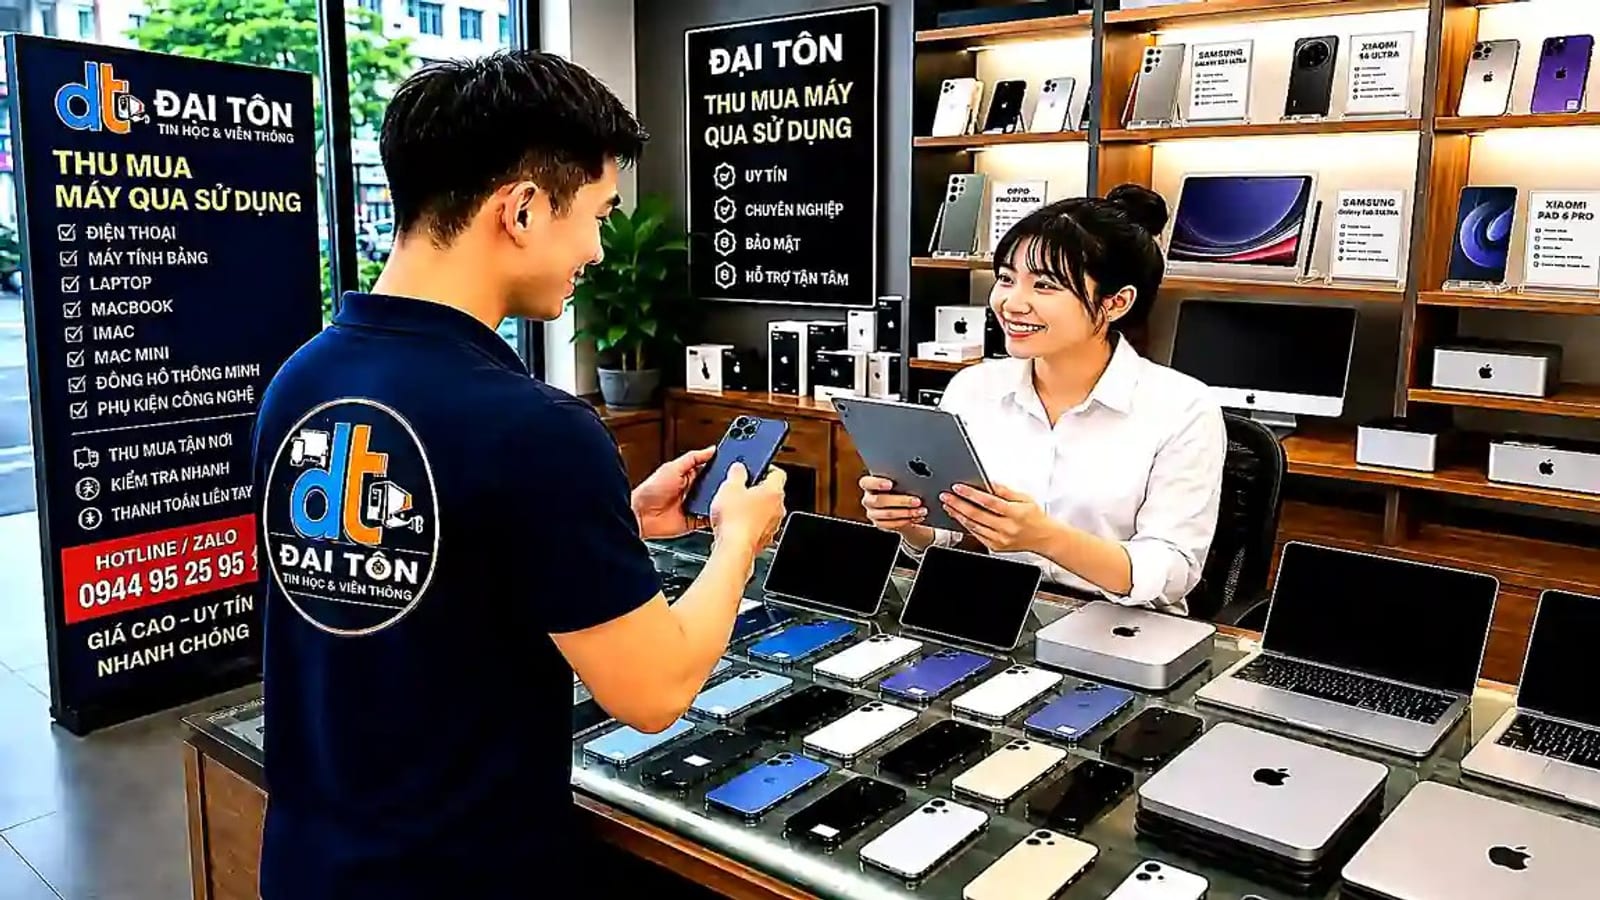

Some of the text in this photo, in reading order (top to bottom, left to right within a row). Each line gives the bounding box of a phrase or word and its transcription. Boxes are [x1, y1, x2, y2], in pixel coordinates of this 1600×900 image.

[709, 30, 843, 77] ĐẠI TÔN
[1198, 48, 1243, 59] SAMSUNG
[1361, 40, 1398, 51] XIAOMI
[704, 78, 854, 115] THU MUA MÁY
[154, 89, 293, 128] ĐẠI TÔN
[157, 123, 179, 136] TIN
[182, 125, 210, 140] HỌC
[212, 128, 221, 139] &
[704, 115, 851, 149] QUA SỬ DỤNG
[52, 150, 193, 179] THU MUA
[745, 165, 788, 183] UY TÍN
[56, 181, 302, 216] MÁY QUA SỬ DỤNG
[1343, 198, 1396, 207] SAMSUNG
[1545, 200, 1587, 210] XIAOMI
[745, 200, 844, 219] CHUYÊN NGHIỆP
[1537, 211, 1594, 221] PAD 6 PRO
[86, 223, 176, 243] ĐIỆN THOẠI
[745, 232, 801, 253] BẢO MẬT
[88, 247, 208, 266] MÁY TÍNH BẢNG
[90, 276, 152, 291] LAPTOP
[765, 270, 791, 287] TRỢ
[792, 269, 818, 288] TẬN
[821, 269, 849, 286] TÂM
[91, 299, 173, 316] MACBOOK
[93, 325, 135, 340] IMAC
[94, 346, 169, 365] MAC MINI
[171, 365, 222, 383] THÔNG
[224, 363, 261, 379] MINH
[97, 385, 255, 416] PHỤ KIỆN CÔNG NGHỆ
[108, 432, 233, 462] THU MUA TẬN NƠI
[111, 461, 230, 491] KIỂM TRA NHANH
[111, 500, 161, 522] THANH
[163, 492, 200, 512] TOÁN
[231, 485, 253, 501] TAY
[96, 529, 238, 571] HOTLINE / ZALO
[279, 543, 333, 575] ĐẠI
[343, 551, 419, 584] TÔN
[79, 573, 143, 609] 0944
[149, 566, 179, 593] 95
[185, 558, 212, 586] 25
[218, 551, 245, 578] 95
[282, 572, 300, 585] TIN
[302, 576, 326, 591] HỌC
[327, 581, 336, 591] &
[87, 622, 127, 650] GIÁ
[131, 615, 176, 639] CAO
[193, 603, 220, 623] UY
[224, 595, 254, 617] TÍN
[98, 623, 249, 677] NHANH CHÓNG
